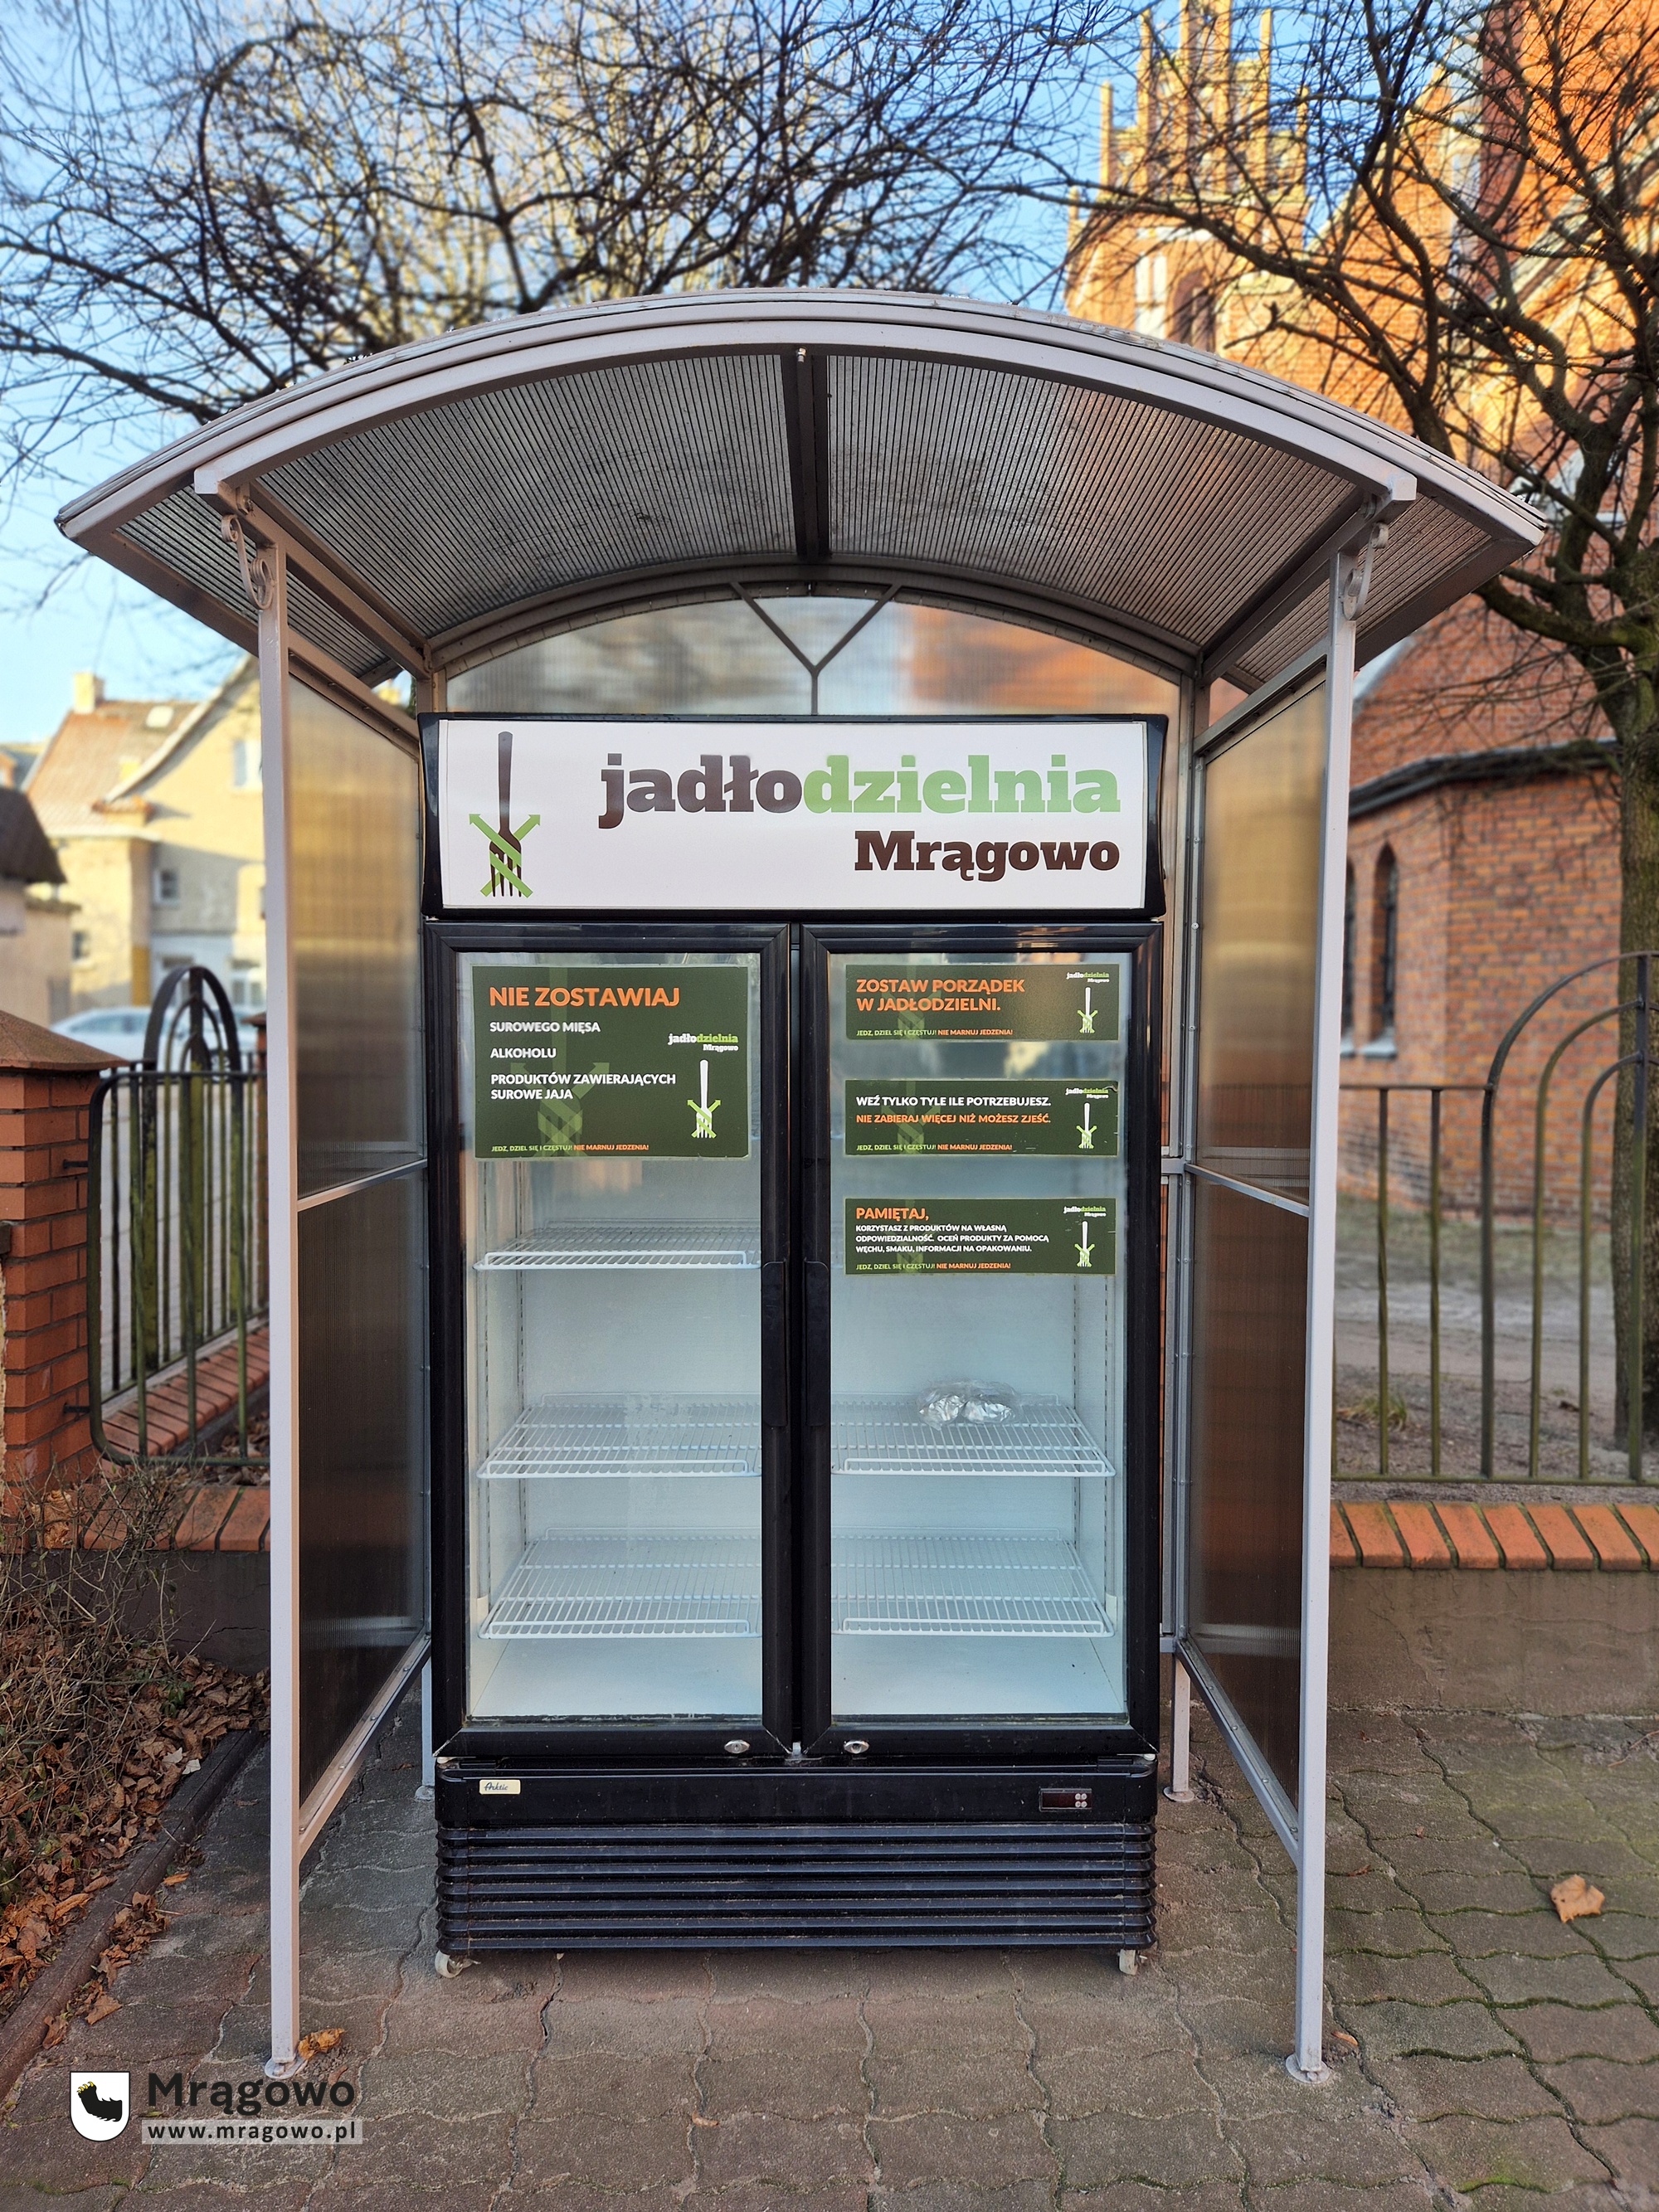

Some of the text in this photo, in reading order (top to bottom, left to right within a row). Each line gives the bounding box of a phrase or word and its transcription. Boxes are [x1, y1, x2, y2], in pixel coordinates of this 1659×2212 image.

[598, 753, 1121, 829] jadłodzielnia
[854, 831, 1120, 882] Mrągowo
[856, 980, 1025, 995] ZOSTAW PORZĄDEK
[489, 987, 680, 1007] NIE ZOSTAWIAJ
[856, 998, 1001, 1011] W JADŁODZIELNI.
[489, 1022, 601, 1034] SUROWEGO MIĘSA
[667, 1033, 738, 1045] jadłodzielnia
[490, 1048, 557, 1058] ALKOHOLU
[490, 1072, 676, 1087] PRODUKTÓW ZAWIERAJĄCYCH
[490, 1089, 573, 1100] SUROWE JAJA
[856, 1094, 1052, 1106] WEŹ TYLKO TYLE ILE POTRZEBUJESZ.
[856, 1112, 1051, 1124] NIE ZABIERAJ WIĘCEJ NIŻ MOŻESZ ZJEŚĆ.
[855, 1208, 929, 1221] PAMIĘTAJ,
[909, 1223, 961, 1232] PRODUKTÓW
[974, 1224, 1007, 1232] WŁASNĄ
[937, 1233, 959, 1242] OCEŃ
[1014, 1234, 1049, 1243] POMOCĄ
[886, 1245, 915, 1253] SMAKU,
[484, 1782, 508, 1791] Arktic
